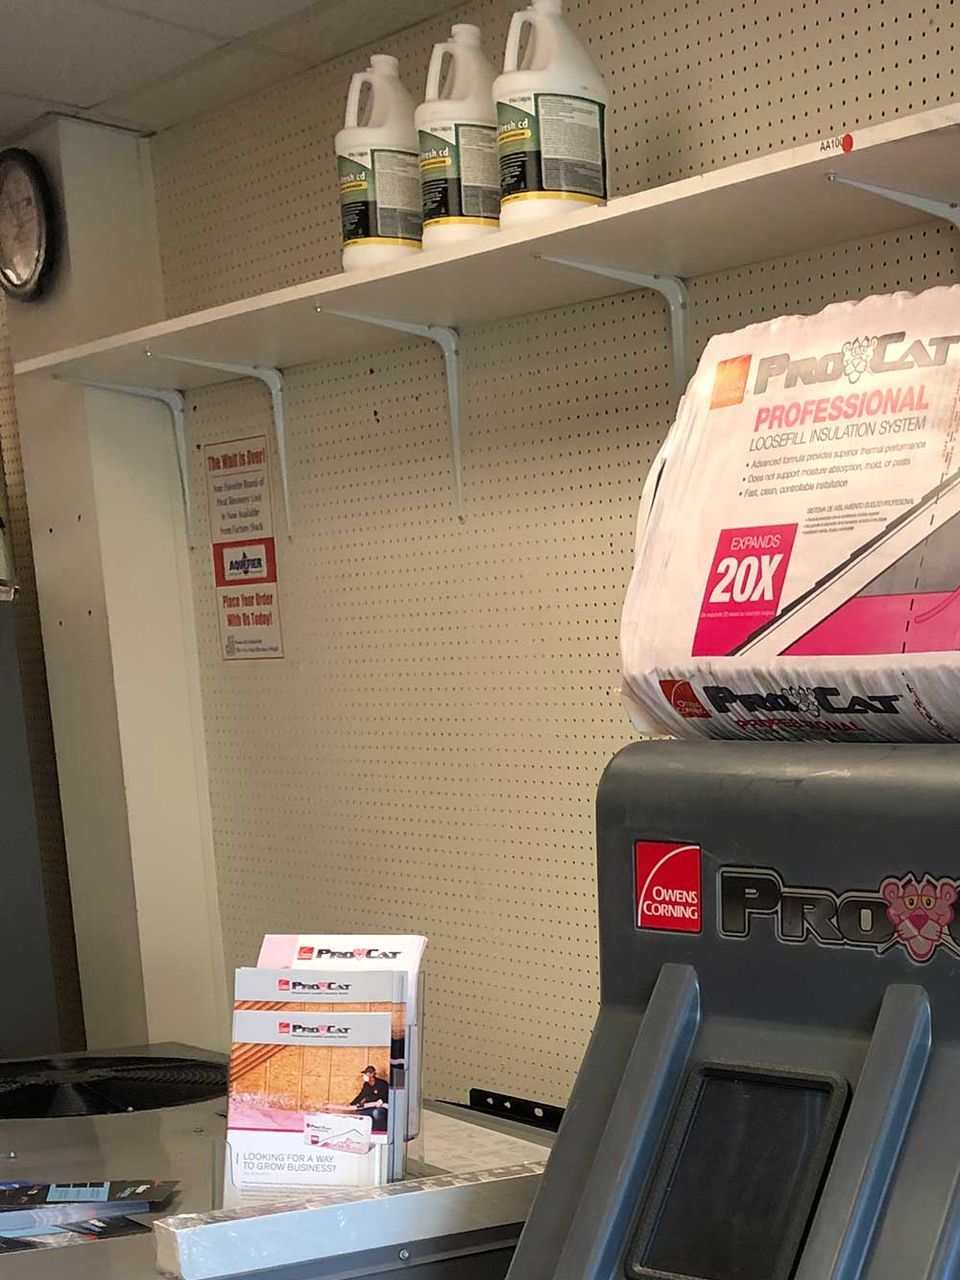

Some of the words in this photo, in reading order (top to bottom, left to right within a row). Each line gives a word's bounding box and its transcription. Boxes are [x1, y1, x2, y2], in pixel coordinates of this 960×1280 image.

[753, 385, 929, 432] PROFESSIONAL
[750, 431, 807, 451] LOOSEFILL
[809, 421, 877, 443] INSULATION
[879, 416, 926, 436] SYSTEM
[751, 458, 781, 468] Advanced
[782, 454, 805, 465] formula
[807, 451, 832, 462] provides
[860, 445, 883, 455] thermal
[885, 441, 926, 454] performance
[208, 456, 221, 472] The
[748, 474, 763, 483] Does
[764, 472, 776, 481] not
[776, 470, 800, 481] support
[884, 459, 892, 467] or
[731, 535, 781, 550] EXPANDS
[709, 553, 783, 603] 20X
[652, 886, 697, 903] OWENS
[643, 901, 698, 919] CORNING
[243, 1153, 285, 1162] LOOKING
[287, 1154, 305, 1163] FOR
[307, 1155, 313, 1163] A
[316, 1155, 334, 1164] WAY
[243, 1161, 255, 1170] TO
[256, 1162, 285, 1171] GROW
[287, 1163, 337, 1173] BUSINESS?
